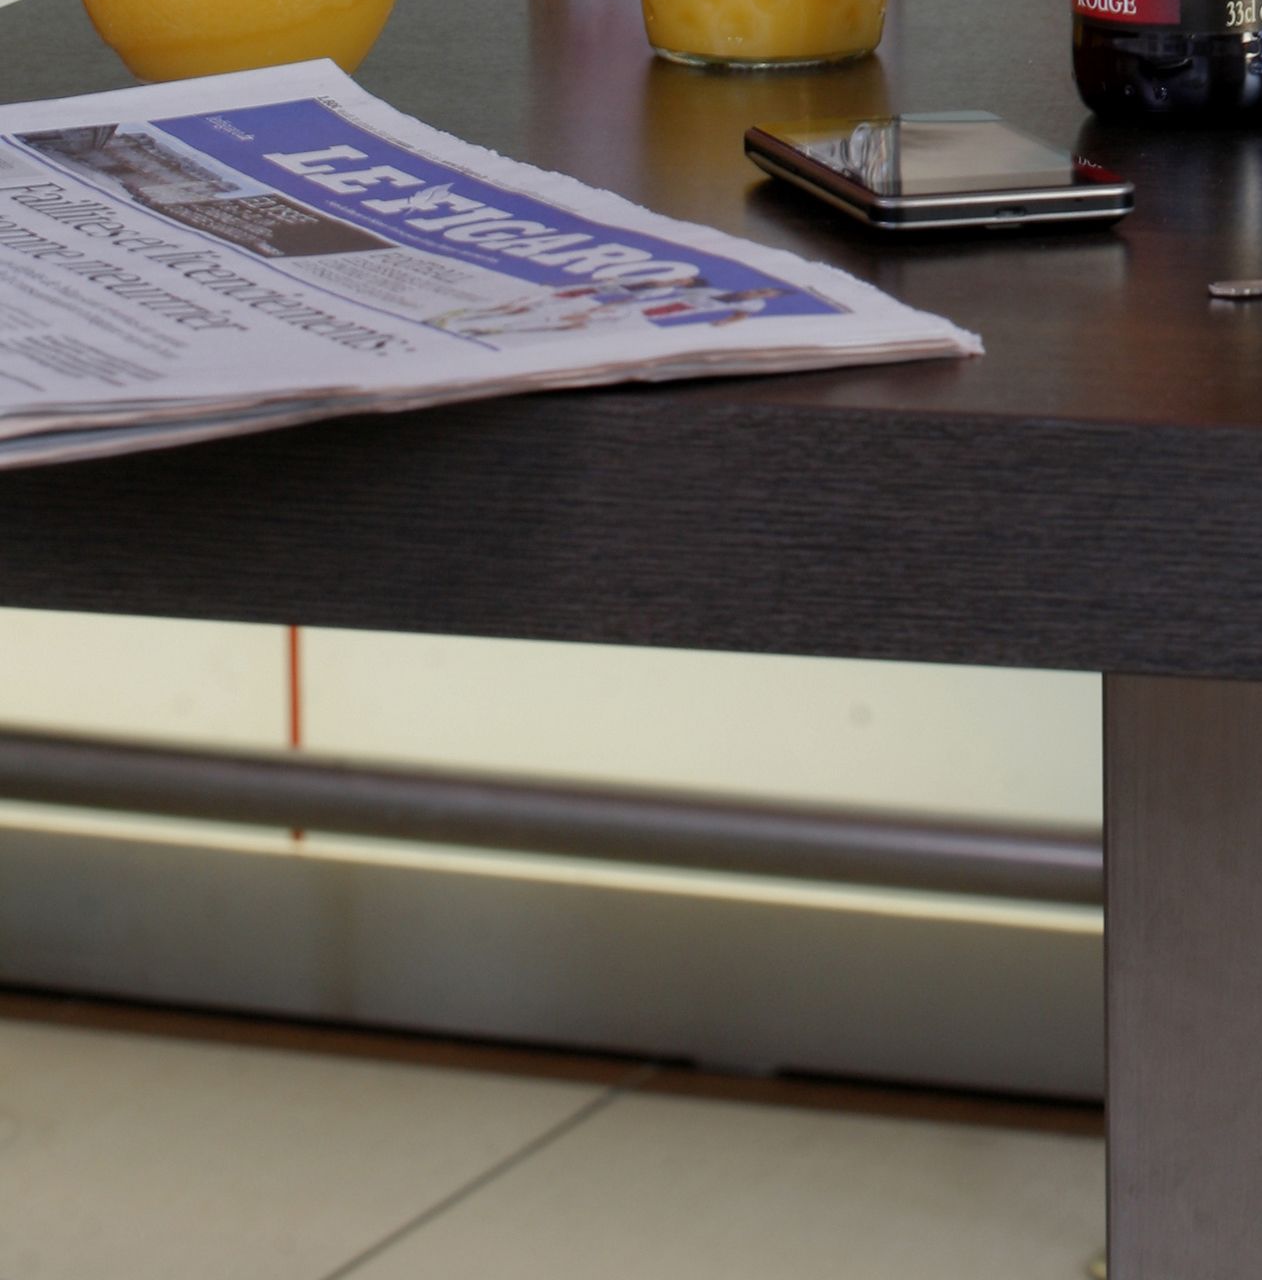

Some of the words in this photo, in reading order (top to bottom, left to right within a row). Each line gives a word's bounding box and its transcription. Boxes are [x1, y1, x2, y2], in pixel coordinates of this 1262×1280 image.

[0, 181, 142, 238] Faillites
[262, 144, 426, 195] LE
[360, 184, 700, 290] FIGARO
[53, 259, 249, 331] meurtrier
